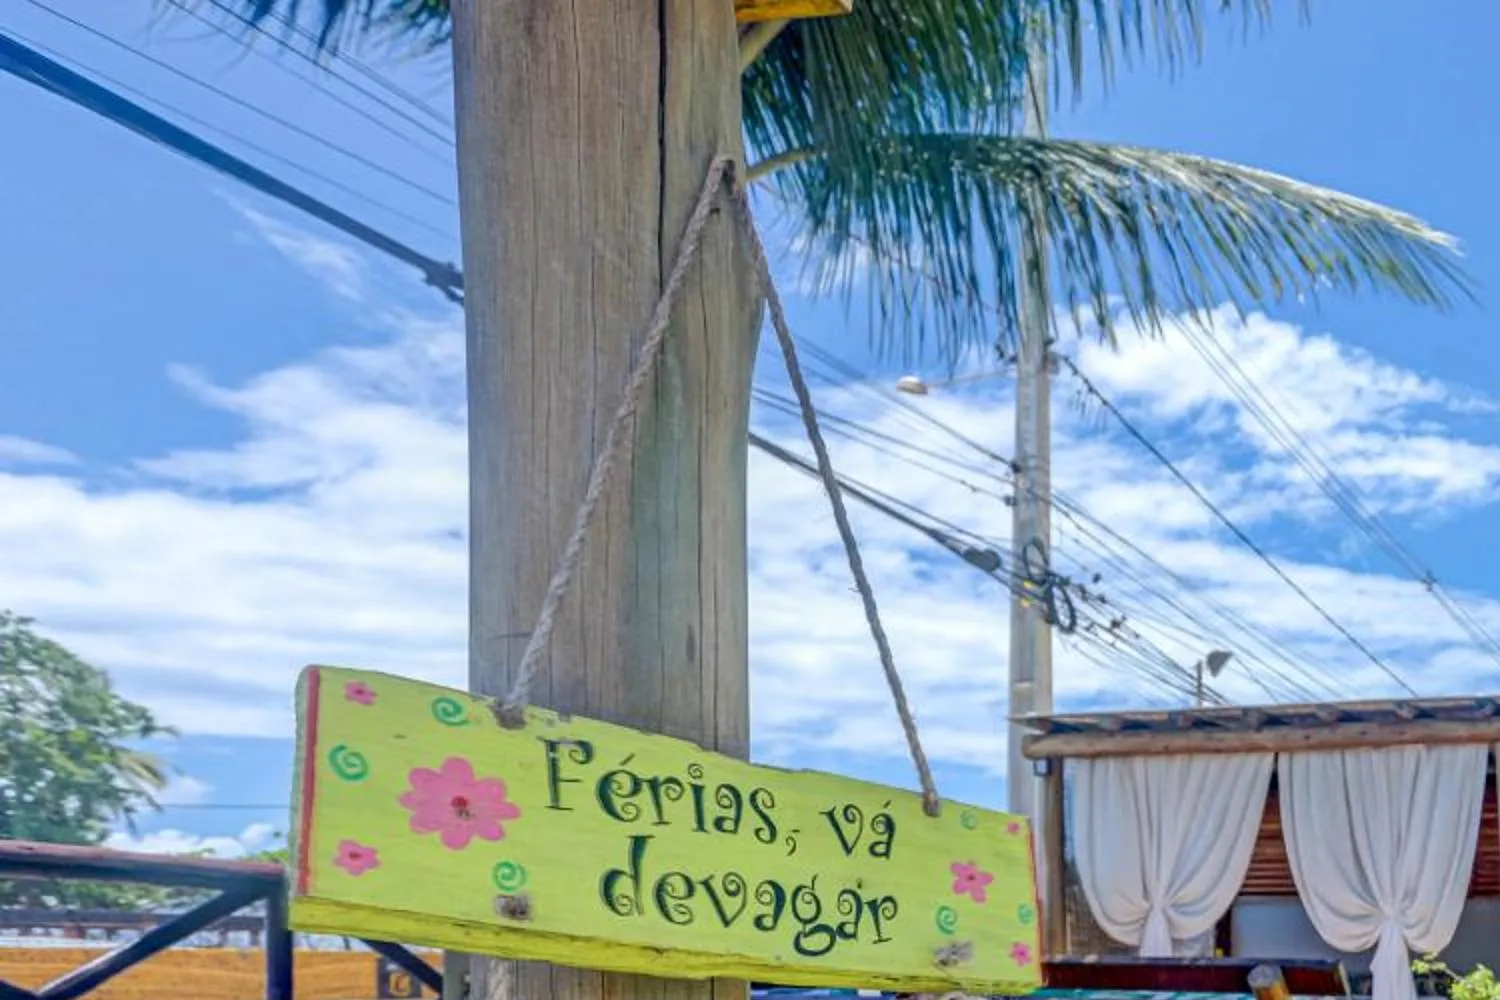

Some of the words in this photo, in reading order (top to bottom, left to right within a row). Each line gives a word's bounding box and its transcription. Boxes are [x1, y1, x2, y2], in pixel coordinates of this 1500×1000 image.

[537, 736, 799, 857] Férias,
[819, 800, 896, 860] vá
[600, 834, 898, 957] devagar
